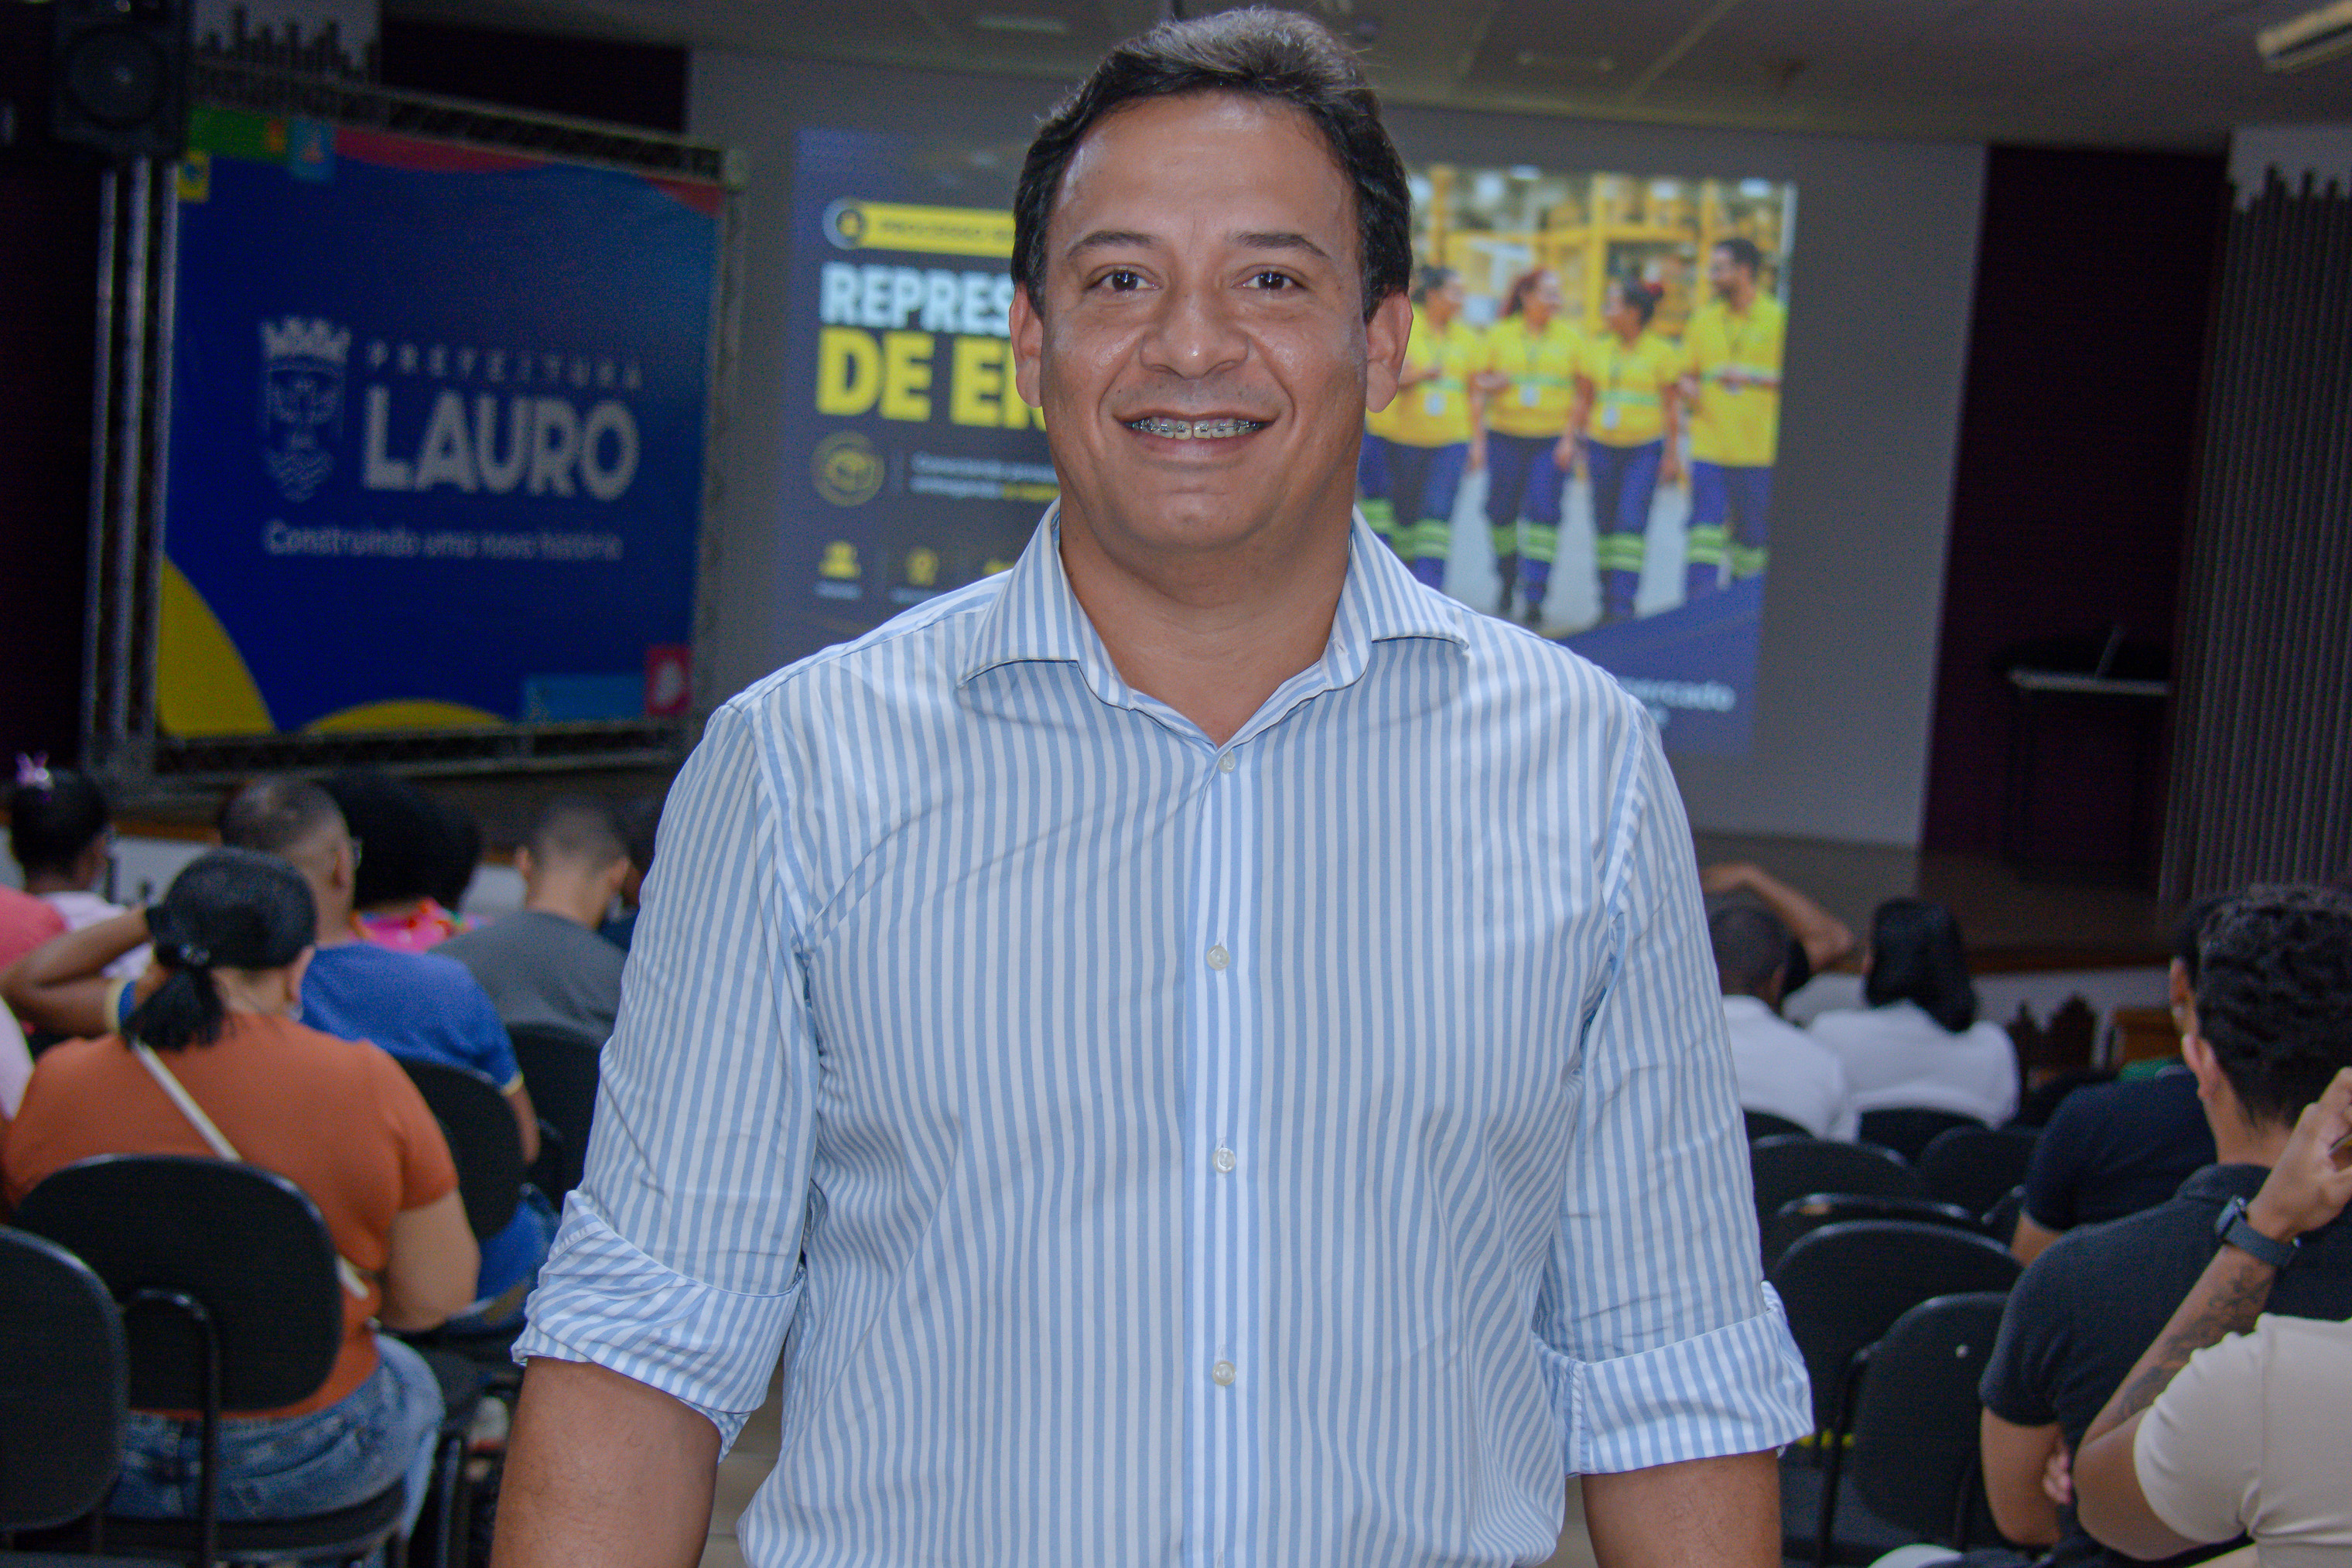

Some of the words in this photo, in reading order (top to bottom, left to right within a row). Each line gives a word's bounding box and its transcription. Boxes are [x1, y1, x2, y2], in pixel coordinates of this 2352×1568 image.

[366, 340, 643, 390] PREFEITURA
[816, 325, 934, 422] DE
[363, 384, 639, 500] LAURO
[263, 519, 419, 558] Construindo
